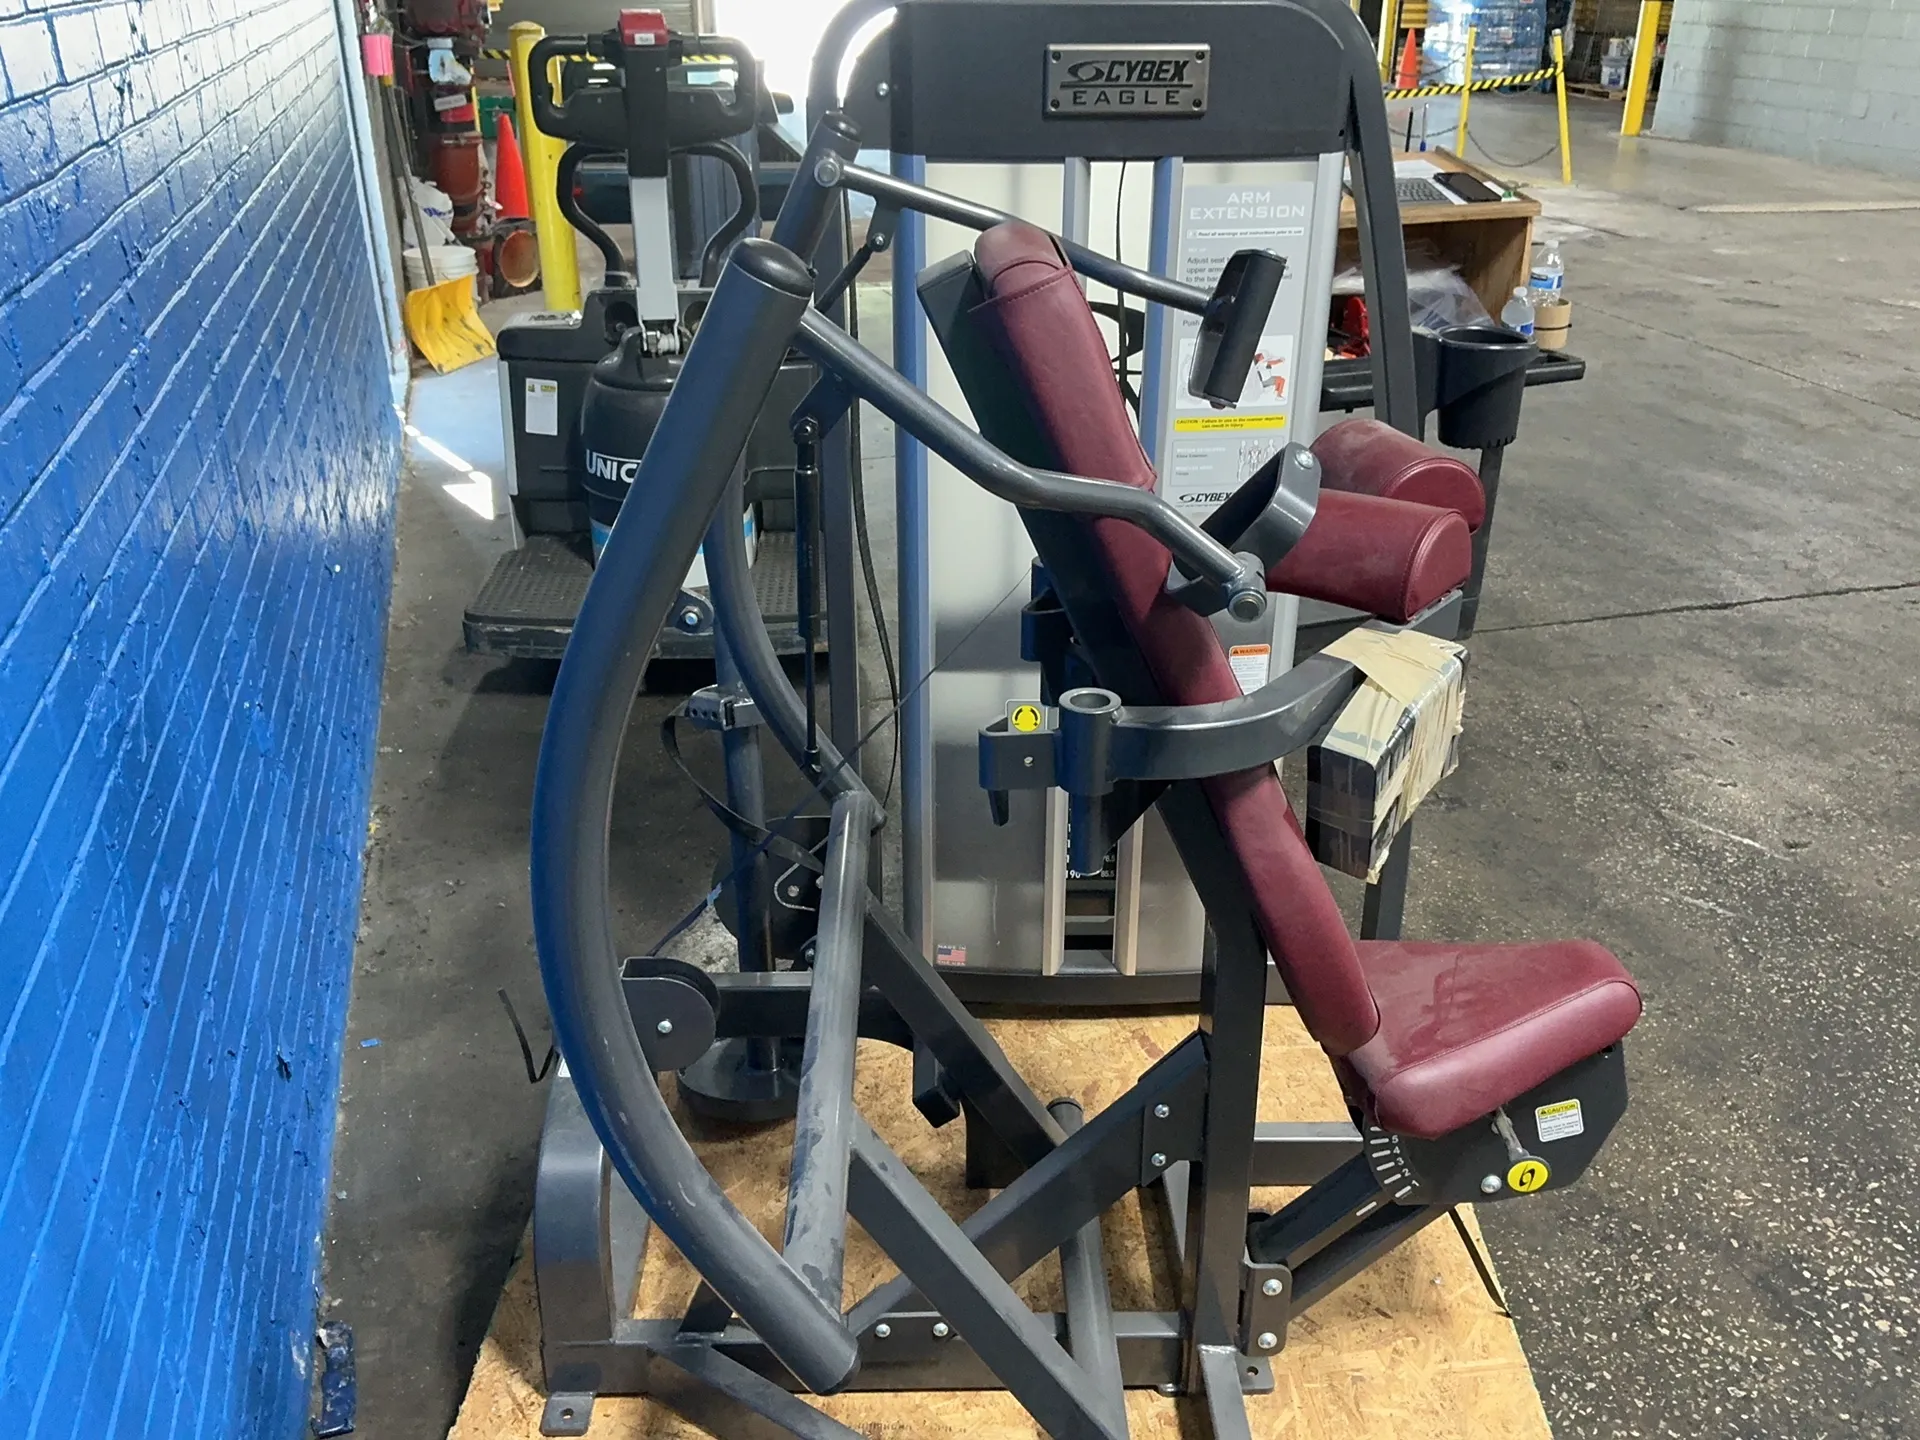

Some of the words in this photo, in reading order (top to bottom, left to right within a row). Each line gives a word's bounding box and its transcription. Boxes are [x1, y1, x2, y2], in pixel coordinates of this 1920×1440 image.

[1105, 60, 1189, 82] CYBEX
[1072, 90, 1180, 105] EAGLE
[1227, 191, 1271, 204] ARM
[1190, 205, 1305, 220] EXTENSION
[1187, 256, 1209, 265] Adjust
[1210, 256, 1225, 264] seat
[1186, 266, 1206, 274] upper
[1183, 319, 1199, 327] Push
[1195, 492, 1232, 502] CYBEX
[1547, 1103, 1576, 1114] CAUTION
[1391, 1134, 1399, 1144] 5
[1393, 1146, 1400, 1154] 4
[1396, 1157, 1405, 1165] 3
[1402, 1168, 1411, 1177] 2
